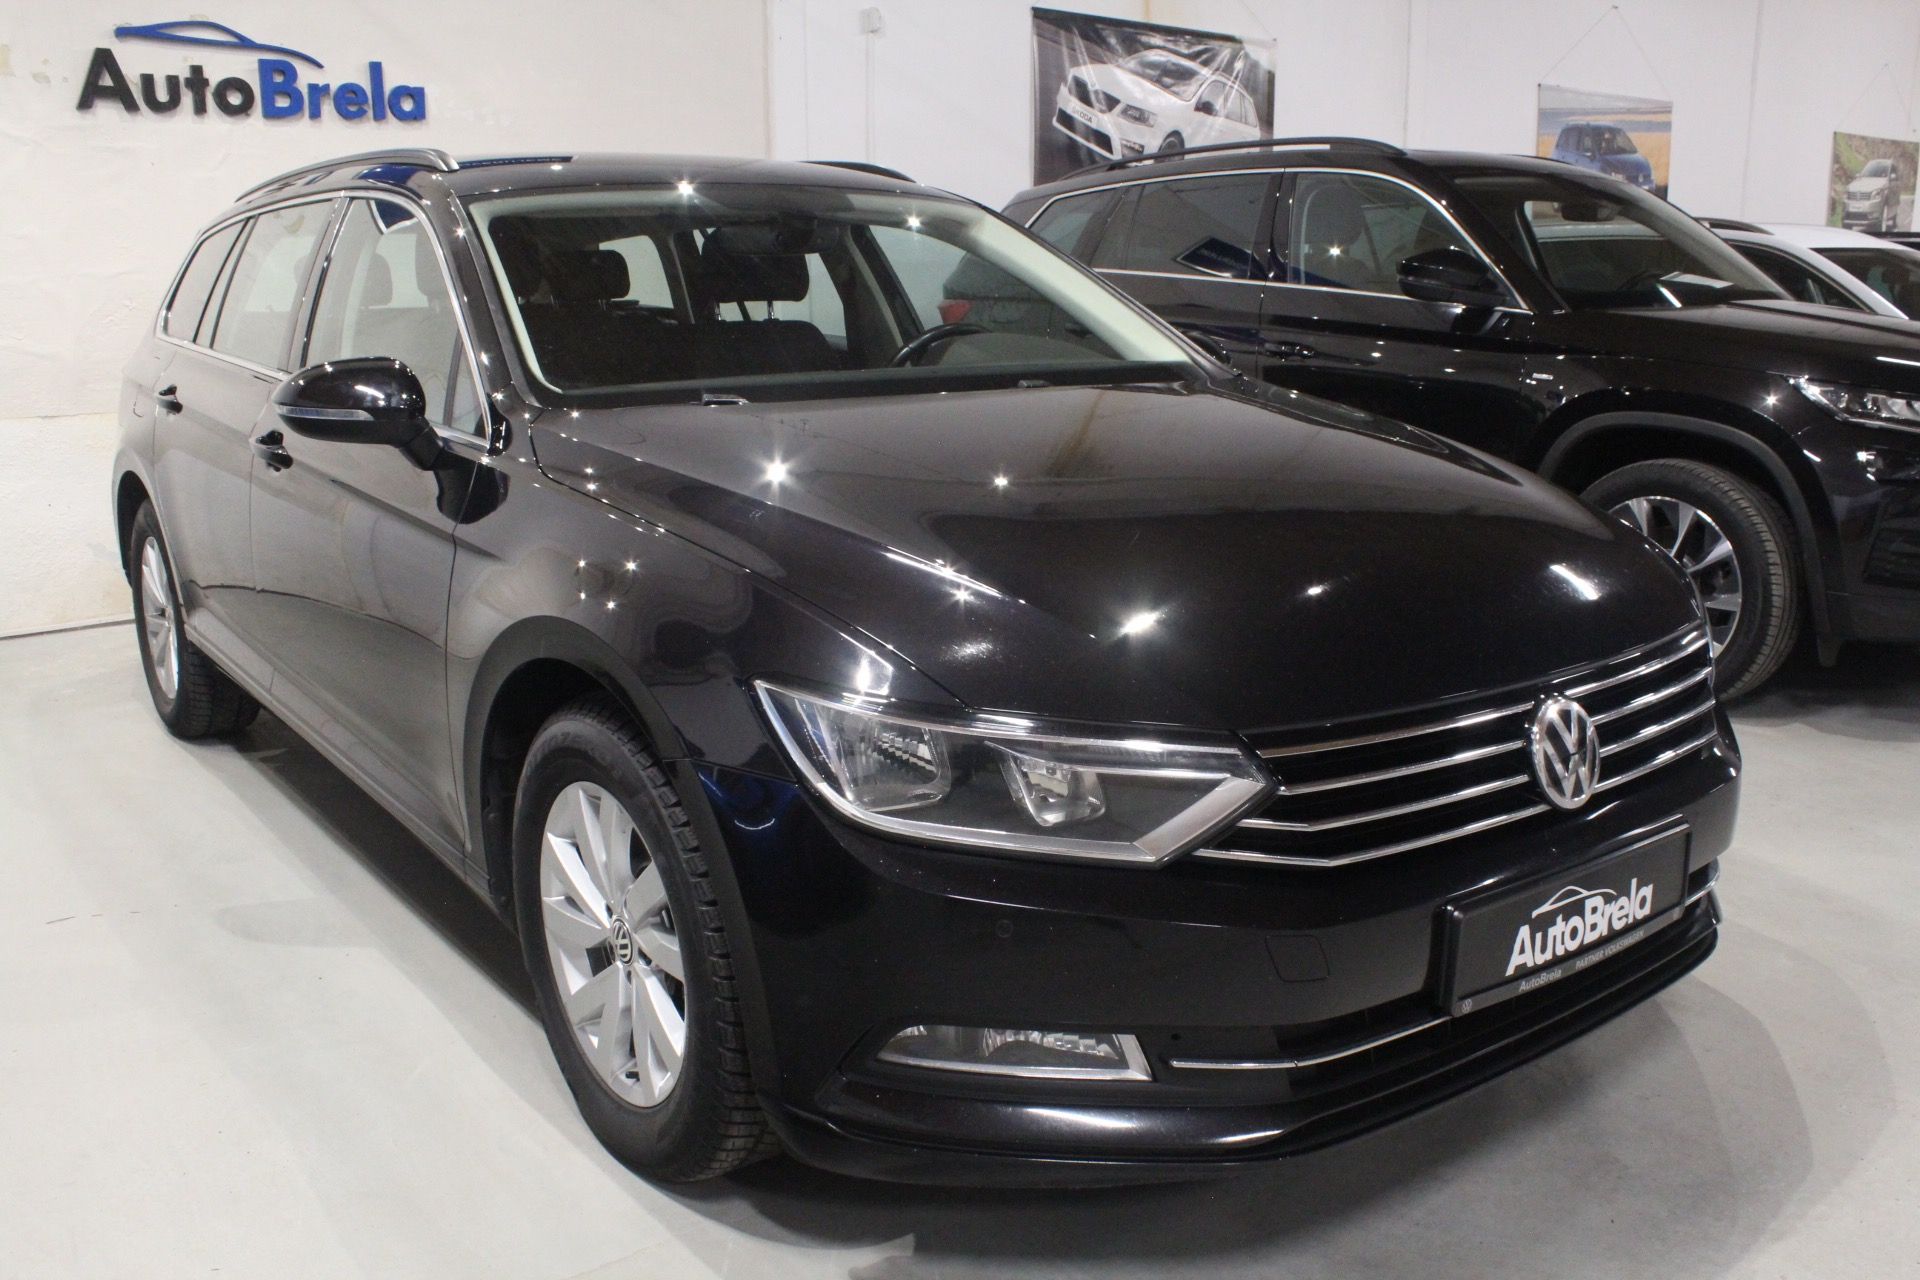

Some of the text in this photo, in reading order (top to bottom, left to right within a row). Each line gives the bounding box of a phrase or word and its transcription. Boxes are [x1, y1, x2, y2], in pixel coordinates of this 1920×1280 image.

[76, 47, 426, 122] AutoBrela
[1505, 878, 1654, 977] AutoBrela
[1518, 968, 1562, 992] AutoBrela
